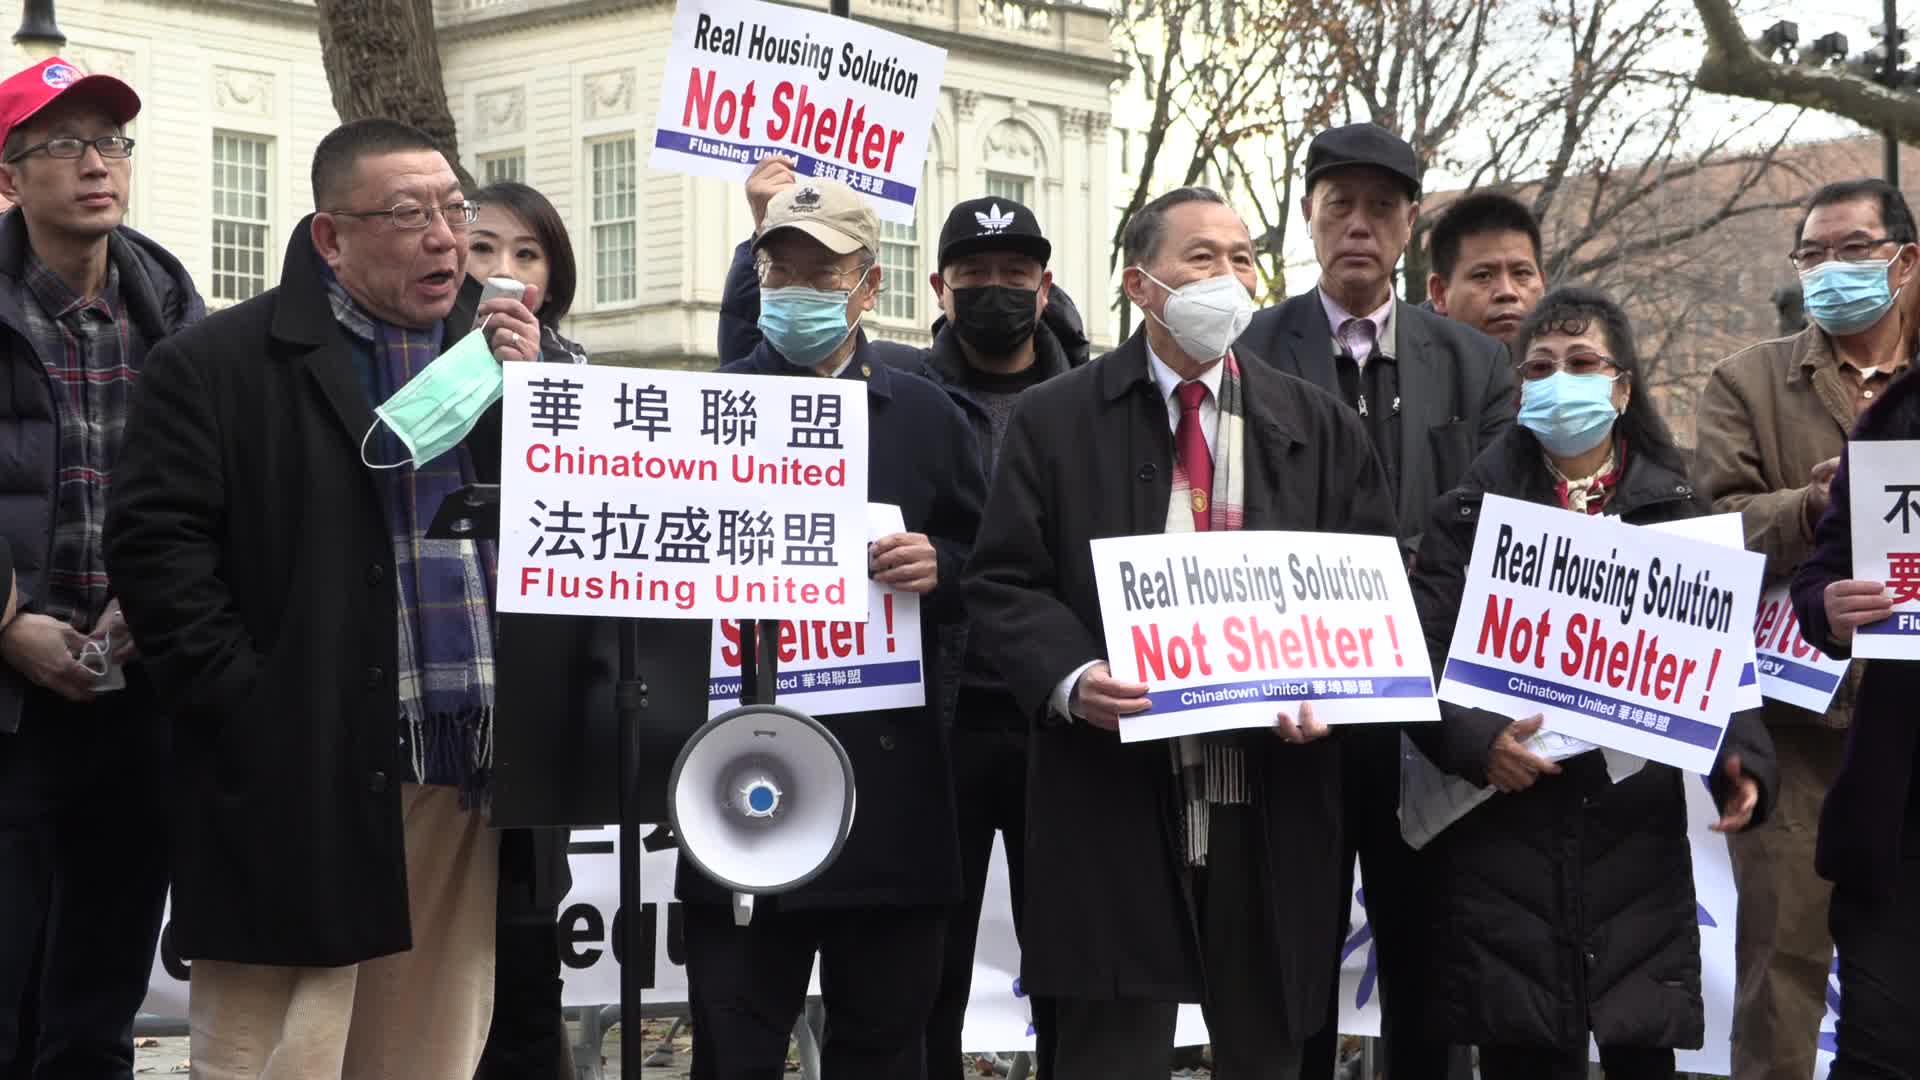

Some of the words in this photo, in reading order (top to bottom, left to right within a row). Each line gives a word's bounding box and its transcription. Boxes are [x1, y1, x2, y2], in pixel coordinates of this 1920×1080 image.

[694, 13, 744, 57] Real
[748, 24, 834, 81] Housing
[838, 42, 919, 99] Solution
[682, 67, 756, 140] Not
[766, 81, 904, 174] Shelter
[688, 137, 750, 163] Flushing
[525, 443, 718, 482] Chinatown
[731, 454, 847, 487] United
[526, 498, 839, 567] 法拉盛聯盟
[520, 566, 697, 610] Flushing
[715, 574, 846, 606] United
[1119, 555, 1179, 612] Real
[1181, 554, 1287, 615] Housing
[1287, 552, 1389, 601] Solution
[1491, 523, 1547, 590] Real
[1548, 536, 1640, 625] Housing
[1643, 556, 1735, 633] Solution
[1131, 620, 1212, 683] Not
[1476, 593, 1551, 668] Not
[1560, 612, 1697, 706] Shelter
[801, 668, 862, 689] 華埠聯盟
[1180, 684, 1259, 706] Chinatown
[1262, 681, 1309, 698] United
[1312, 679, 1374, 697] 華埠聯盟
[1508, 676, 1576, 705] Chinatown
[1577, 694, 1617, 717] United
[1617, 704, 1671, 733] 華埠聯盟
